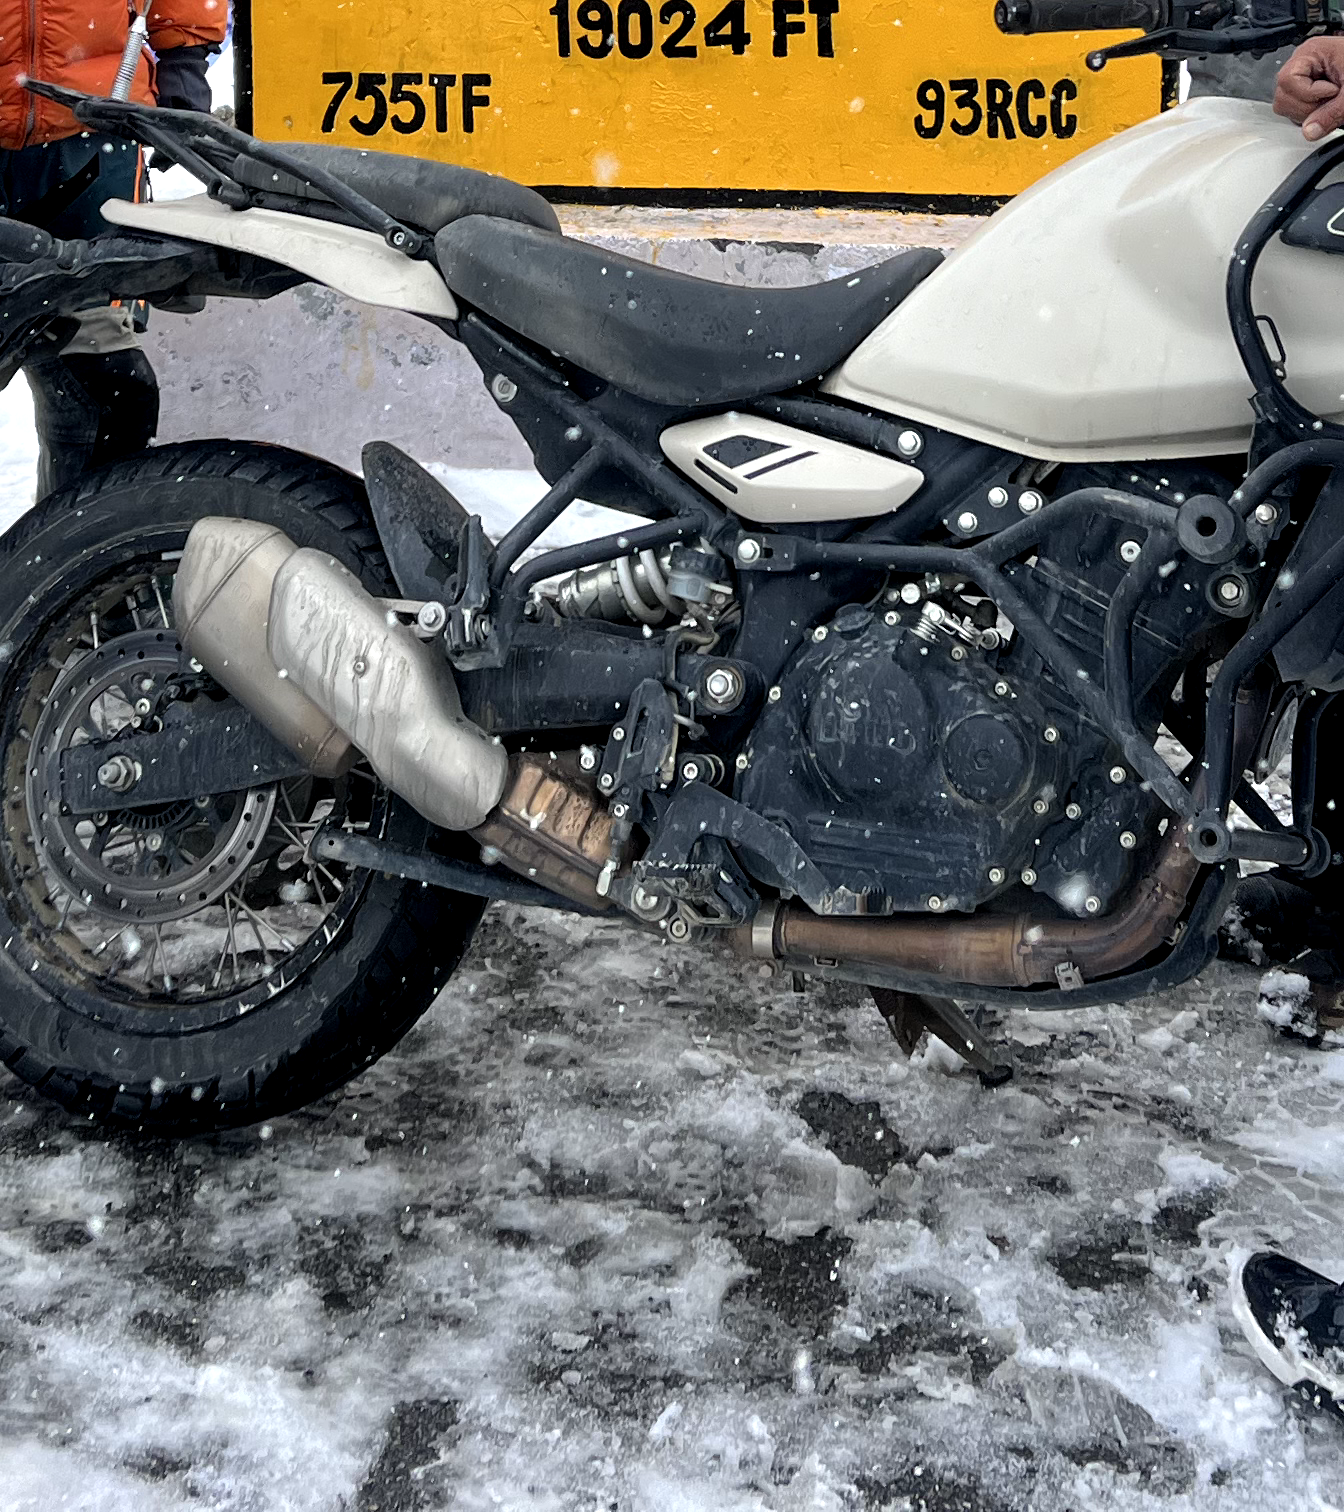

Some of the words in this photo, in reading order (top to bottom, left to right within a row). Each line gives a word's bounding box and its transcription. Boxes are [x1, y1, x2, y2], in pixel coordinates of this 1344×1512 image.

[773, 0, 839, 58] FT
[322, 72, 491, 136] 755TF
[915, 79, 1077, 139] 93RCC
